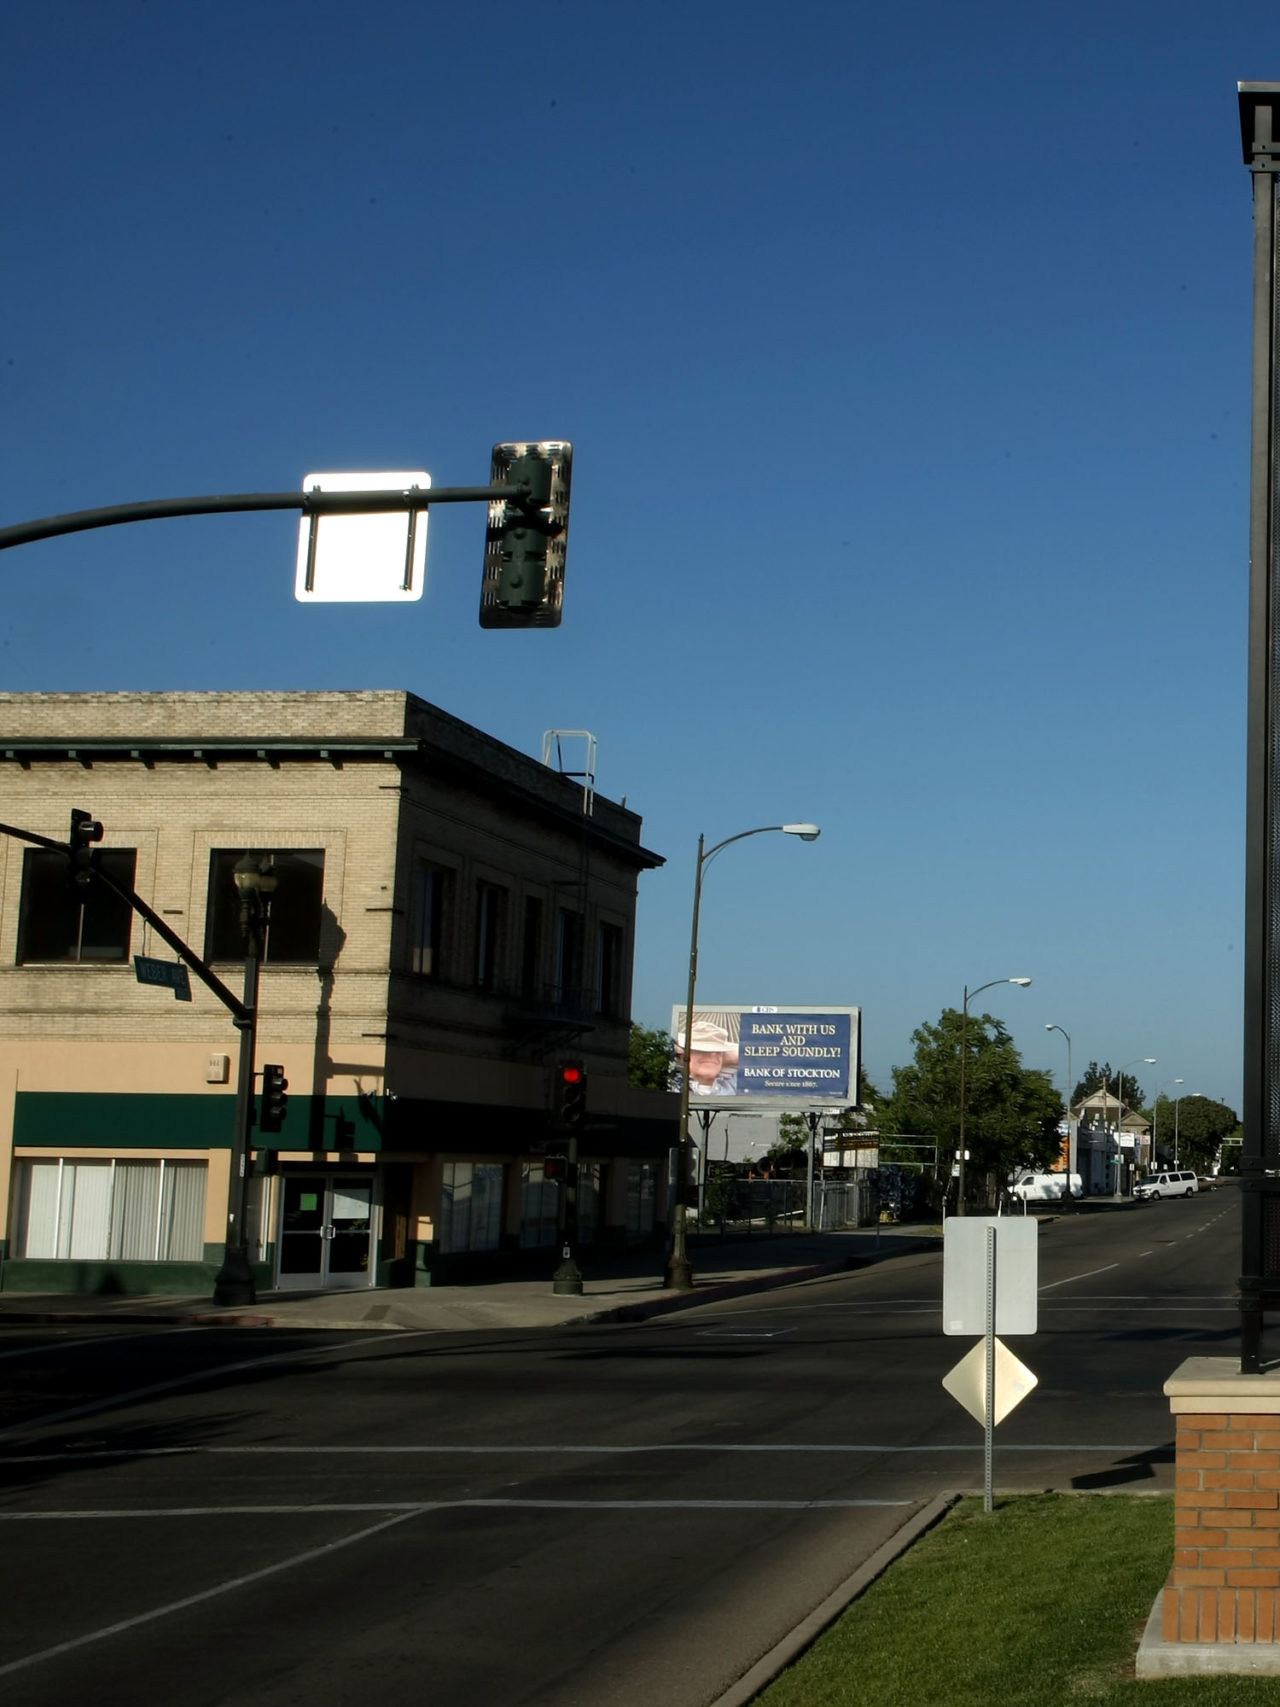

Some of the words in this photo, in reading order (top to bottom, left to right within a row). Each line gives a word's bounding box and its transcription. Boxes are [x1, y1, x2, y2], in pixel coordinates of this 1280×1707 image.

[752, 1024, 783, 1034] BANK
[786, 1024, 817, 1035] WITH
[820, 1025, 835, 1035] US
[780, 1036, 806, 1045] AND
[744, 1046, 780, 1056] SLEEP
[782, 1047, 841, 1057] SOUNDLY!
[744, 1068, 771, 1077] BANK
[772, 1069, 785, 1077] OF
[787, 1069, 840, 1078] STOCKTON
